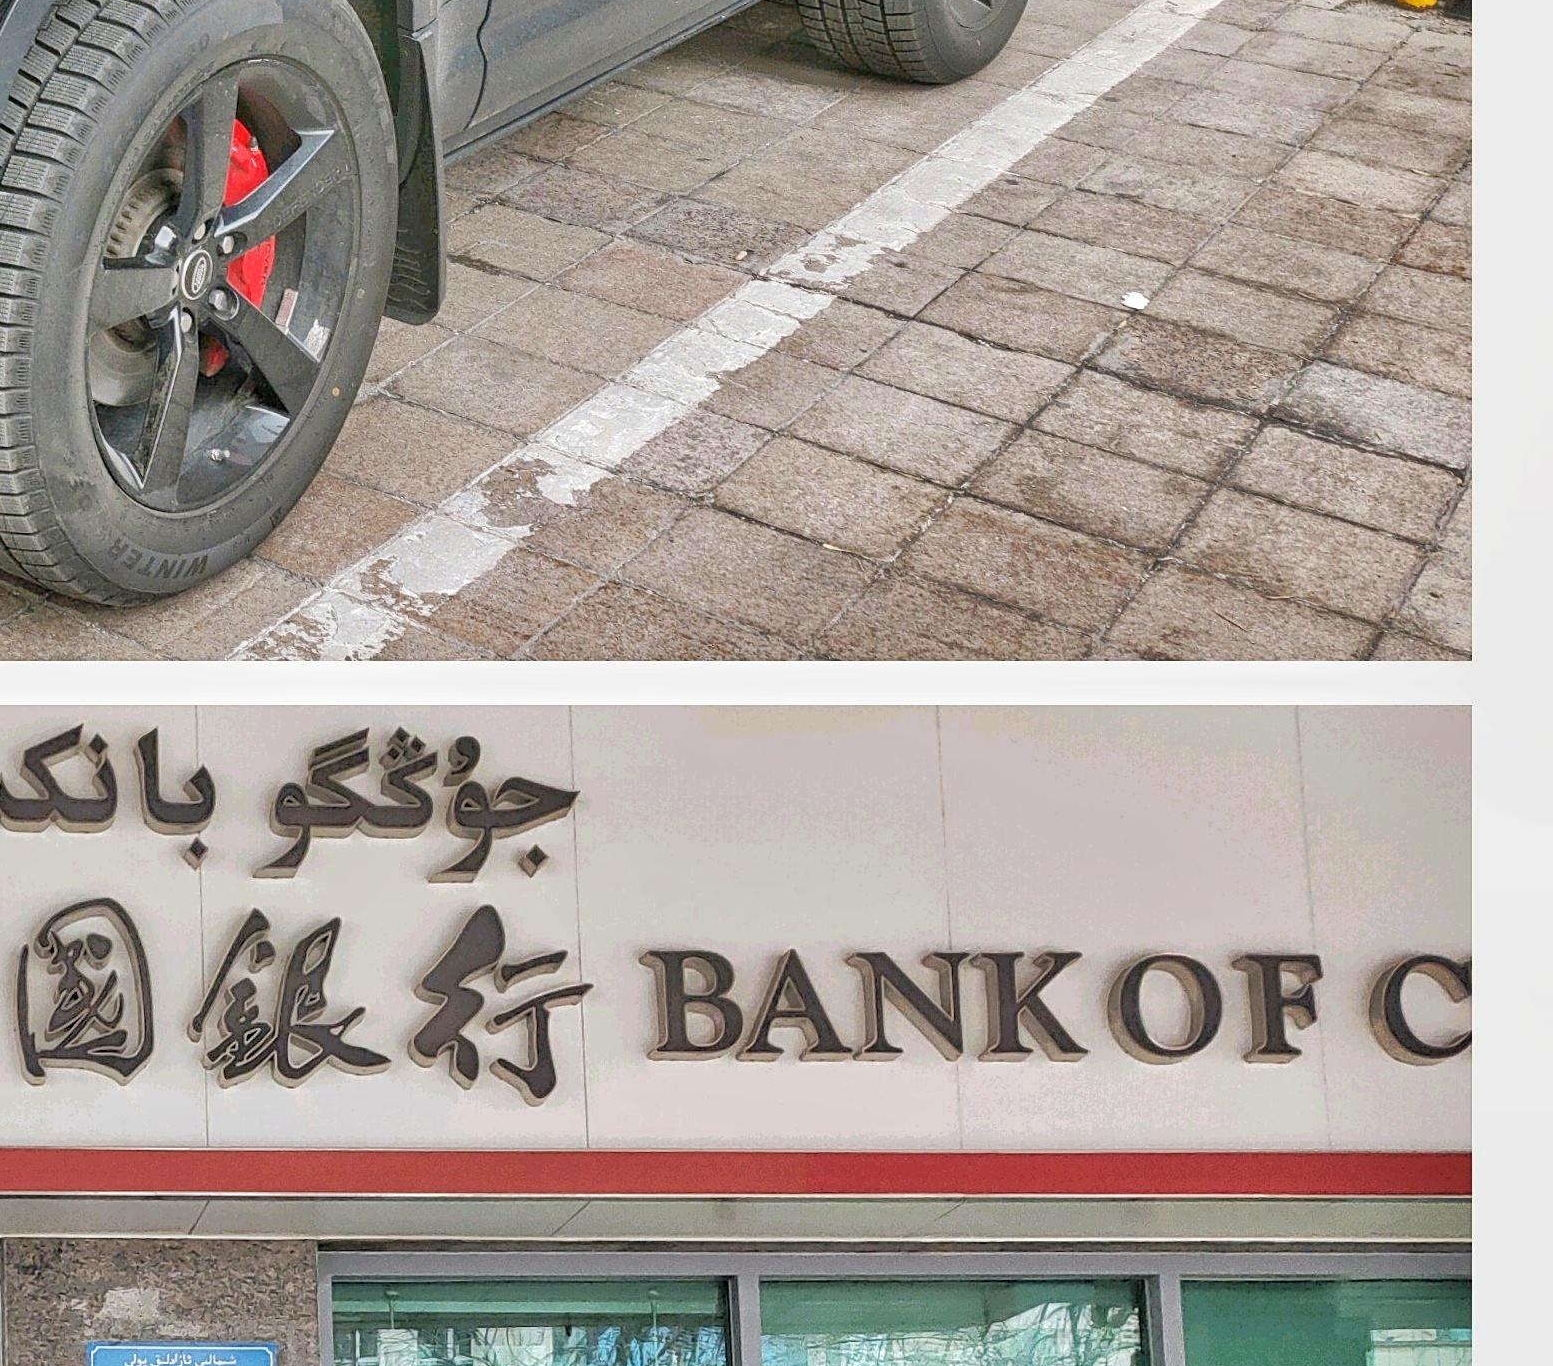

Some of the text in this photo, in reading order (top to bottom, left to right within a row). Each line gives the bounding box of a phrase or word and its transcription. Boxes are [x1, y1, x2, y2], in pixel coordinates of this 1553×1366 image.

[106, 537, 209, 580] WINTER
[638, 948, 1090, 1063] BANK
[1107, 952, 1325, 1065] OF
